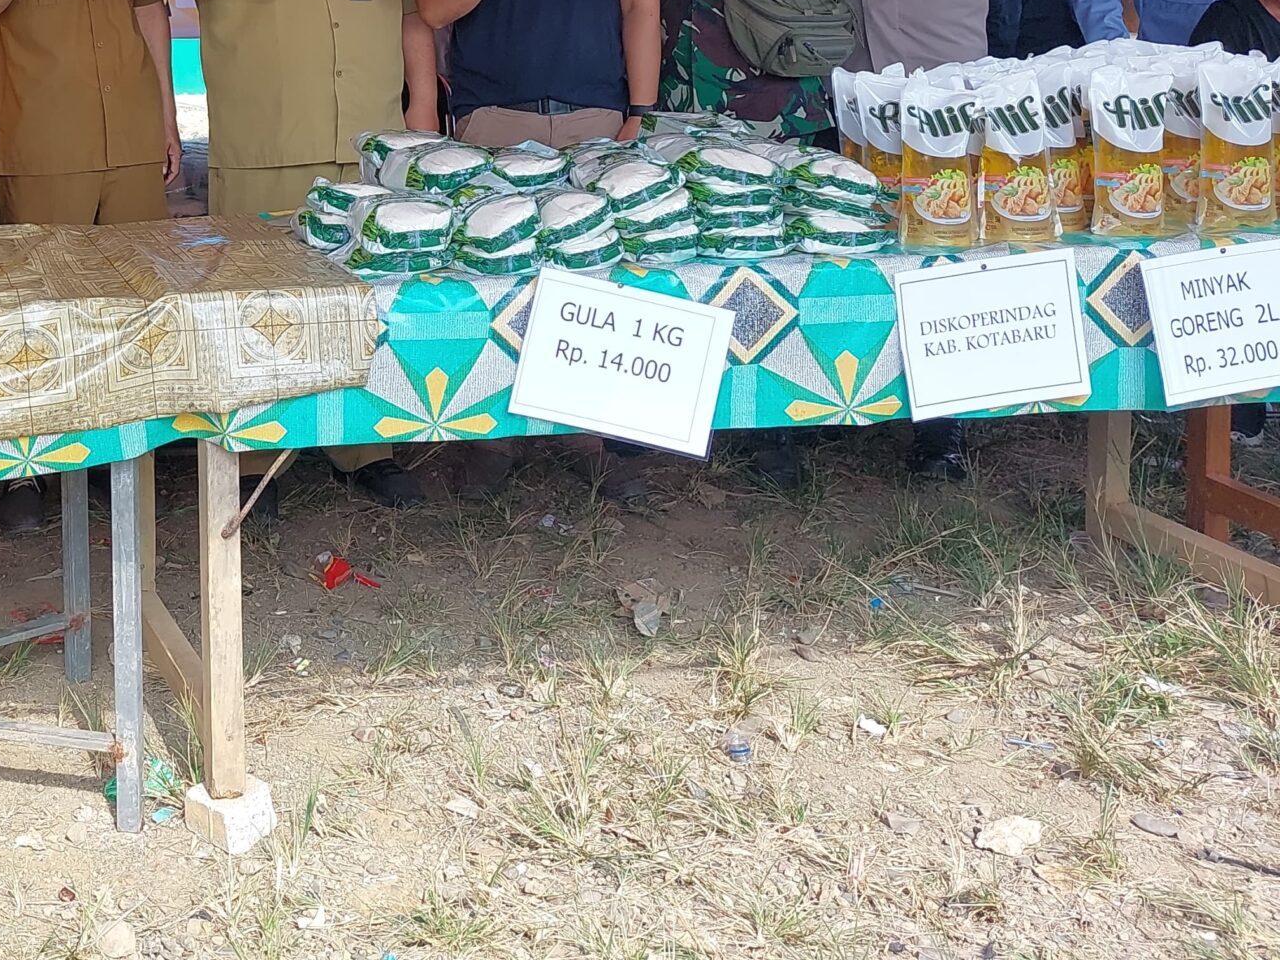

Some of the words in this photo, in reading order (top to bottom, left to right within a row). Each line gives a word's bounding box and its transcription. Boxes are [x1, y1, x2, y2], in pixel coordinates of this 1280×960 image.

[1180, 272, 1251, 301] MINYAK
[561, 301, 616, 333] GULA
[633, 319, 642, 338] 1
[651, 322, 684, 347] KG
[920, 302, 1057, 337] DISKOPERINDAG
[1169, 308, 1244, 339] GORENG
[1256, 302, 1280, 325] 2L
[924, 339, 961, 358] KAB.
[966, 324, 1057, 352] KOTABARU
[1184, 353, 1213, 378] Rp.
[1217, 340, 1278, 367] 32.000
[555, 339, 587, 366] Rp.
[598, 348, 671, 383] 14.000
